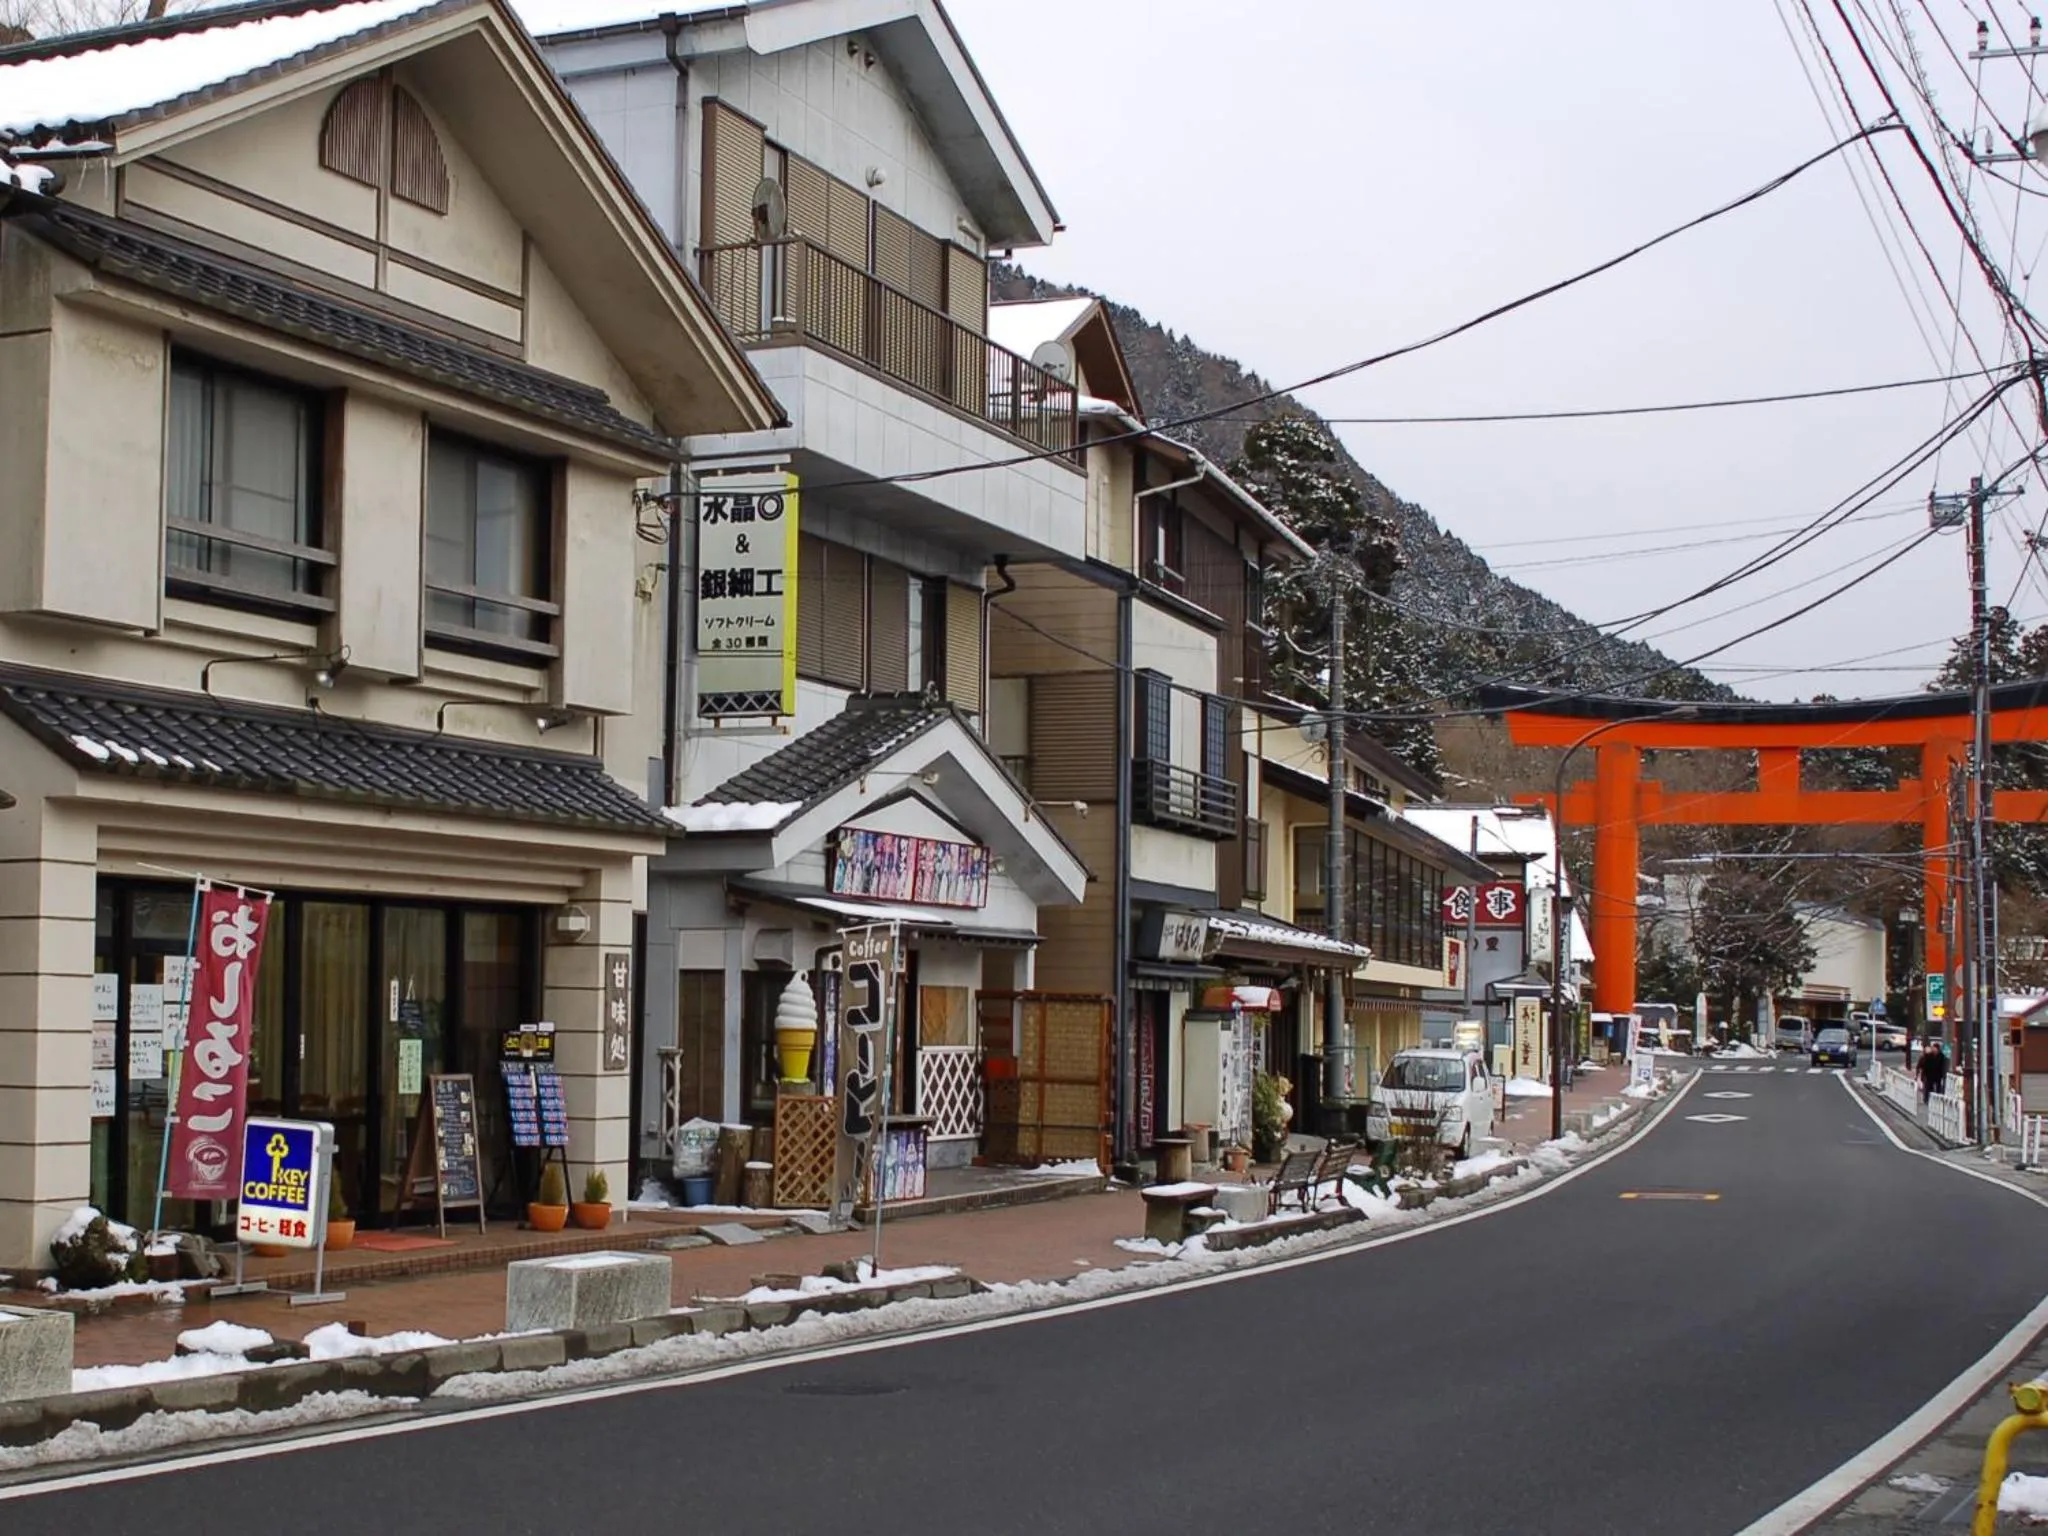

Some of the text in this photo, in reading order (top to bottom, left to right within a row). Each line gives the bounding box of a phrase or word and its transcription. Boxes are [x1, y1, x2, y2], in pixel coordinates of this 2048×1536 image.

[735, 534, 750, 554] &
[702, 568, 782, 600] 銀細工
[704, 613, 776, 630] ソフトクリーム
[848, 938, 888, 959] Coffee
[187, 904, 260, 1133] おしるこ
[610, 960, 629, 1063] 甘味処
[278, 1167, 309, 1187] KEY
[244, 1181, 306, 1204] COFFEE
